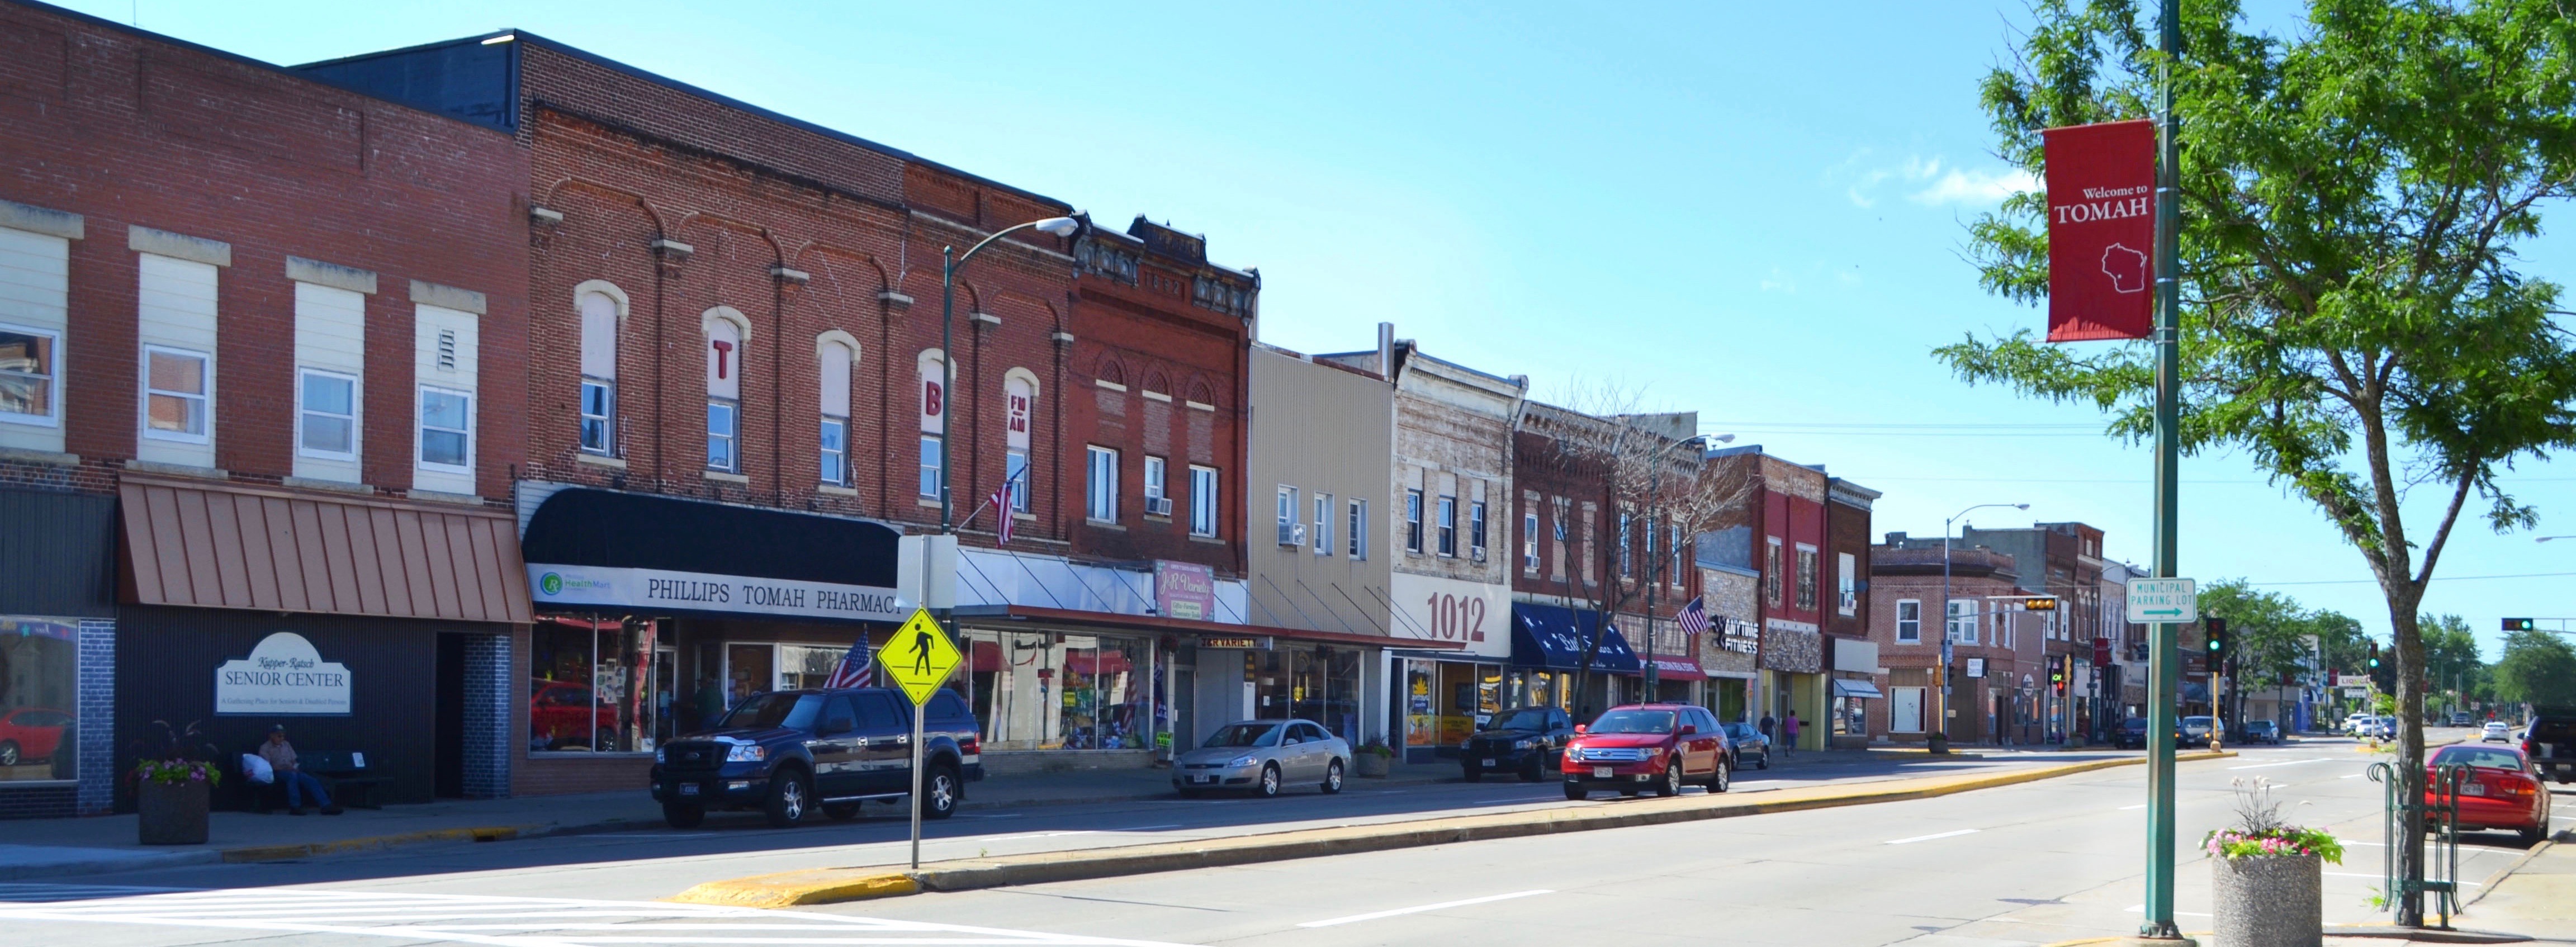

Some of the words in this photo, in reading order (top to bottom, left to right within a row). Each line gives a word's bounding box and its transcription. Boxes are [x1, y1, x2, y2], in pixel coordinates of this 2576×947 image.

[2083, 186, 2134, 200] Welcome
[2136, 185, 2148, 194] to
[2054, 197, 2148, 224] TOMAH
[713, 340, 732, 380] T
[926, 381, 942, 416] B
[1011, 395, 1026, 411] FM
[1010, 416, 1025, 433] AM
[648, 578, 730, 603] PHILLIPS
[743, 585, 805, 608] TOMAH
[1180, 573, 1209, 599] Variety
[2137, 583, 2186, 593] MUNICIPAL
[2130, 595, 2171, 605] PARKING
[2176, 595, 2192, 605] LOT
[1428, 592, 1485, 642] 1012
[1725, 618, 1759, 638] ANYTIME
[1219, 638, 1257, 647] VARIETY
[1725, 638, 1758, 655] FITNESS
[258, 656, 315, 670] Kupper-Ratsch
[225, 671, 282, 685] SENIOR
[285, 673, 343, 686] CENTER
